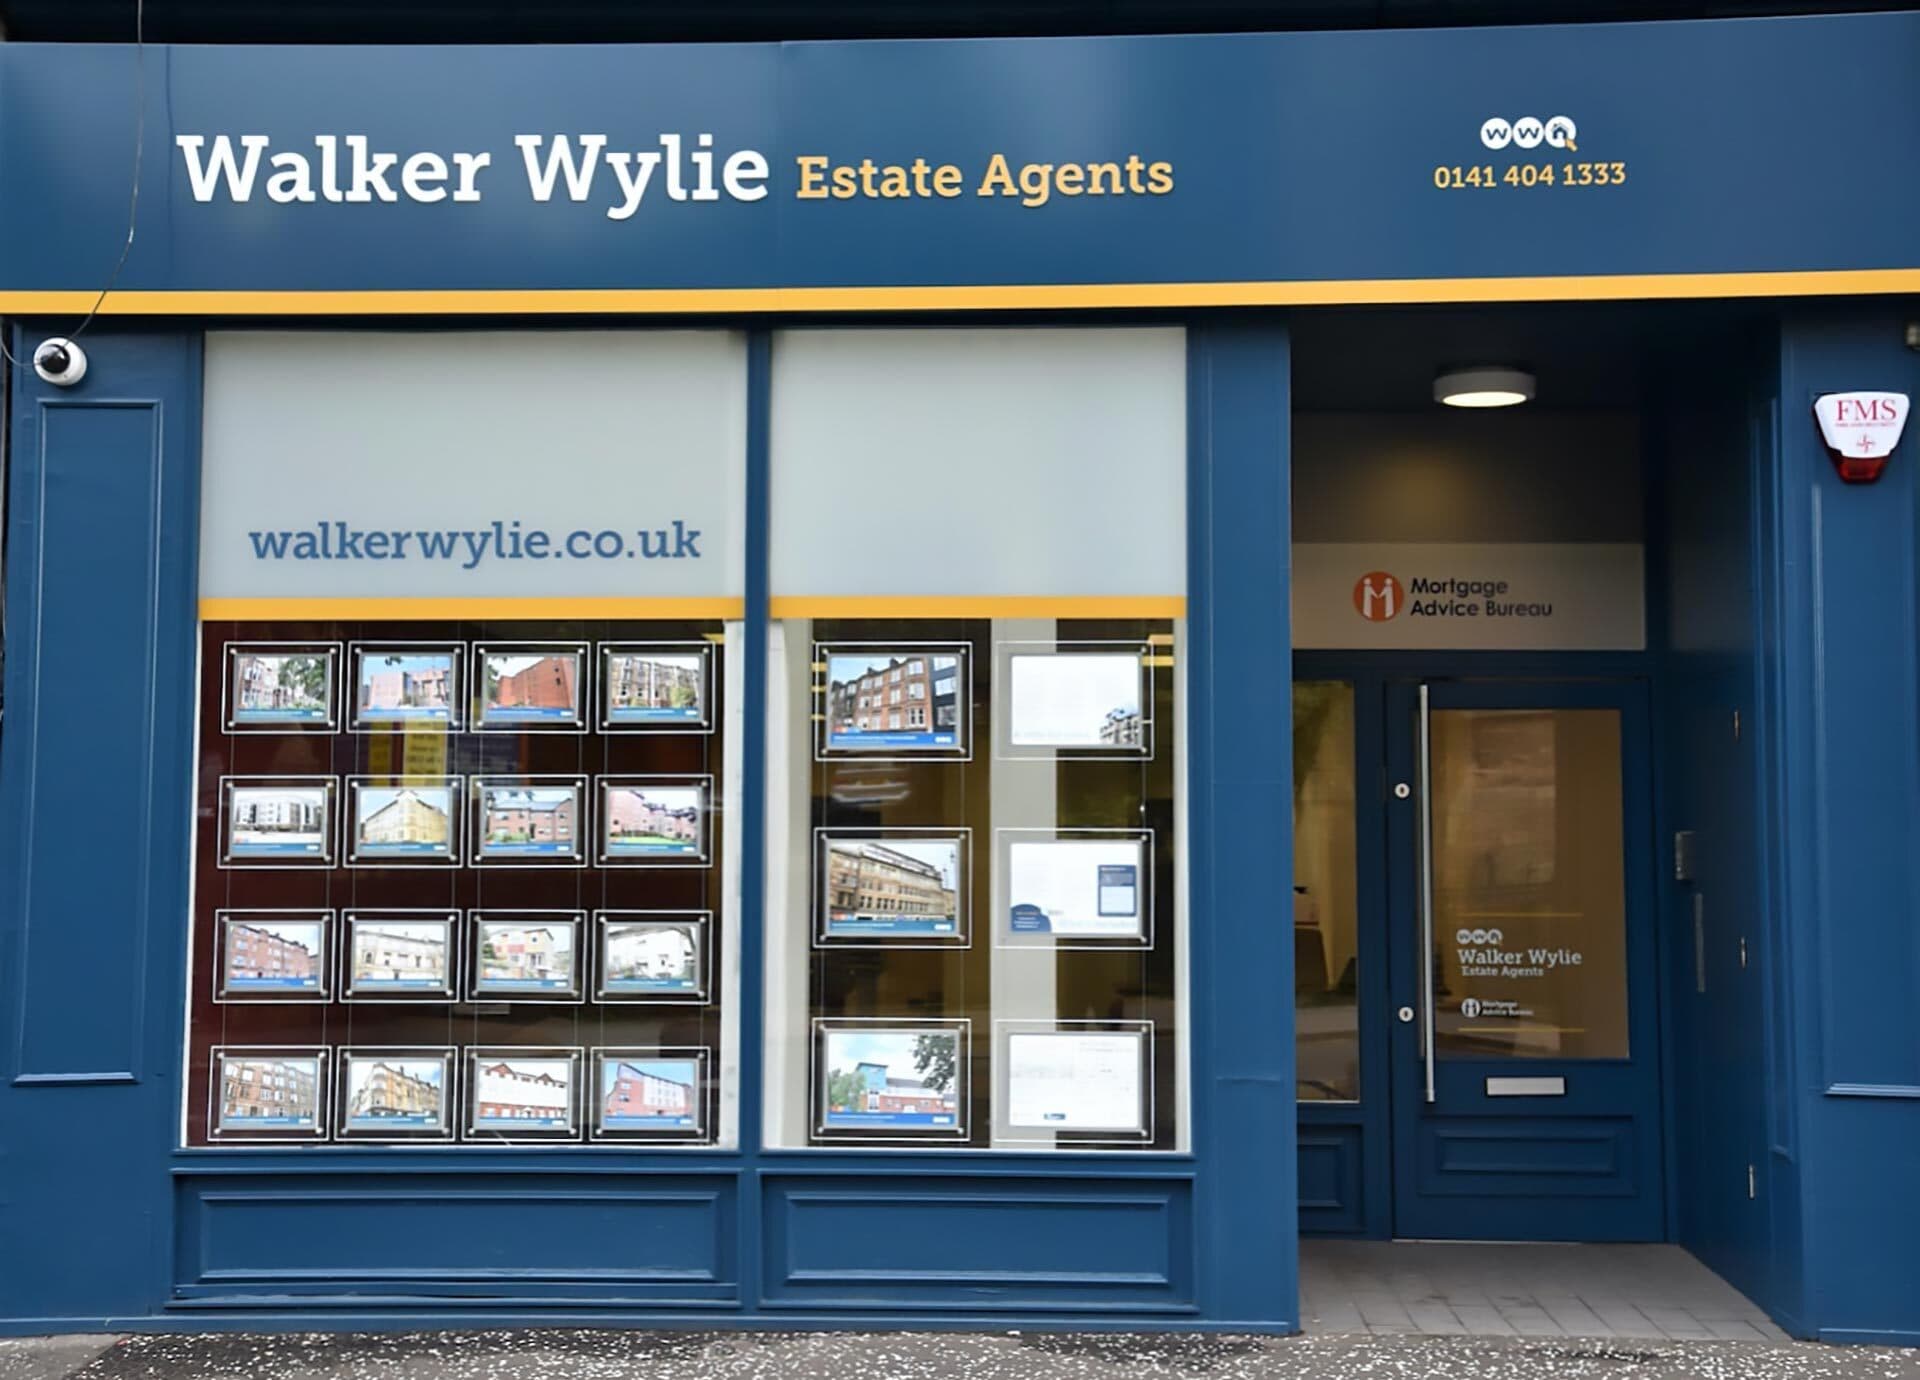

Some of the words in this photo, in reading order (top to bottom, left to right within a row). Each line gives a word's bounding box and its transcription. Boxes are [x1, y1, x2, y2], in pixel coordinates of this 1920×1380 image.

[176, 134, 491, 203] Walker
[515, 133, 770, 220] Wylie
[796, 156, 963, 199] Estate
[977, 153, 1175, 208] Agents
[1433, 165, 1497, 189] 0141
[1503, 163, 1555, 187] 404
[1562, 161, 1627, 186] 1333
[1837, 399, 1895, 421] FMS
[248, 520, 701, 570] walkerwylie.co.uk
[1410, 576, 1509, 599] Mortgage
[1410, 599, 1480, 617] Advice
[1486, 599, 1553, 617] Bureau
[1457, 948, 1524, 965] Walker
[1527, 948, 1582, 968] Wylie
[1462, 966, 1498, 977] Estate
[1501, 966, 1543, 977] Agents
